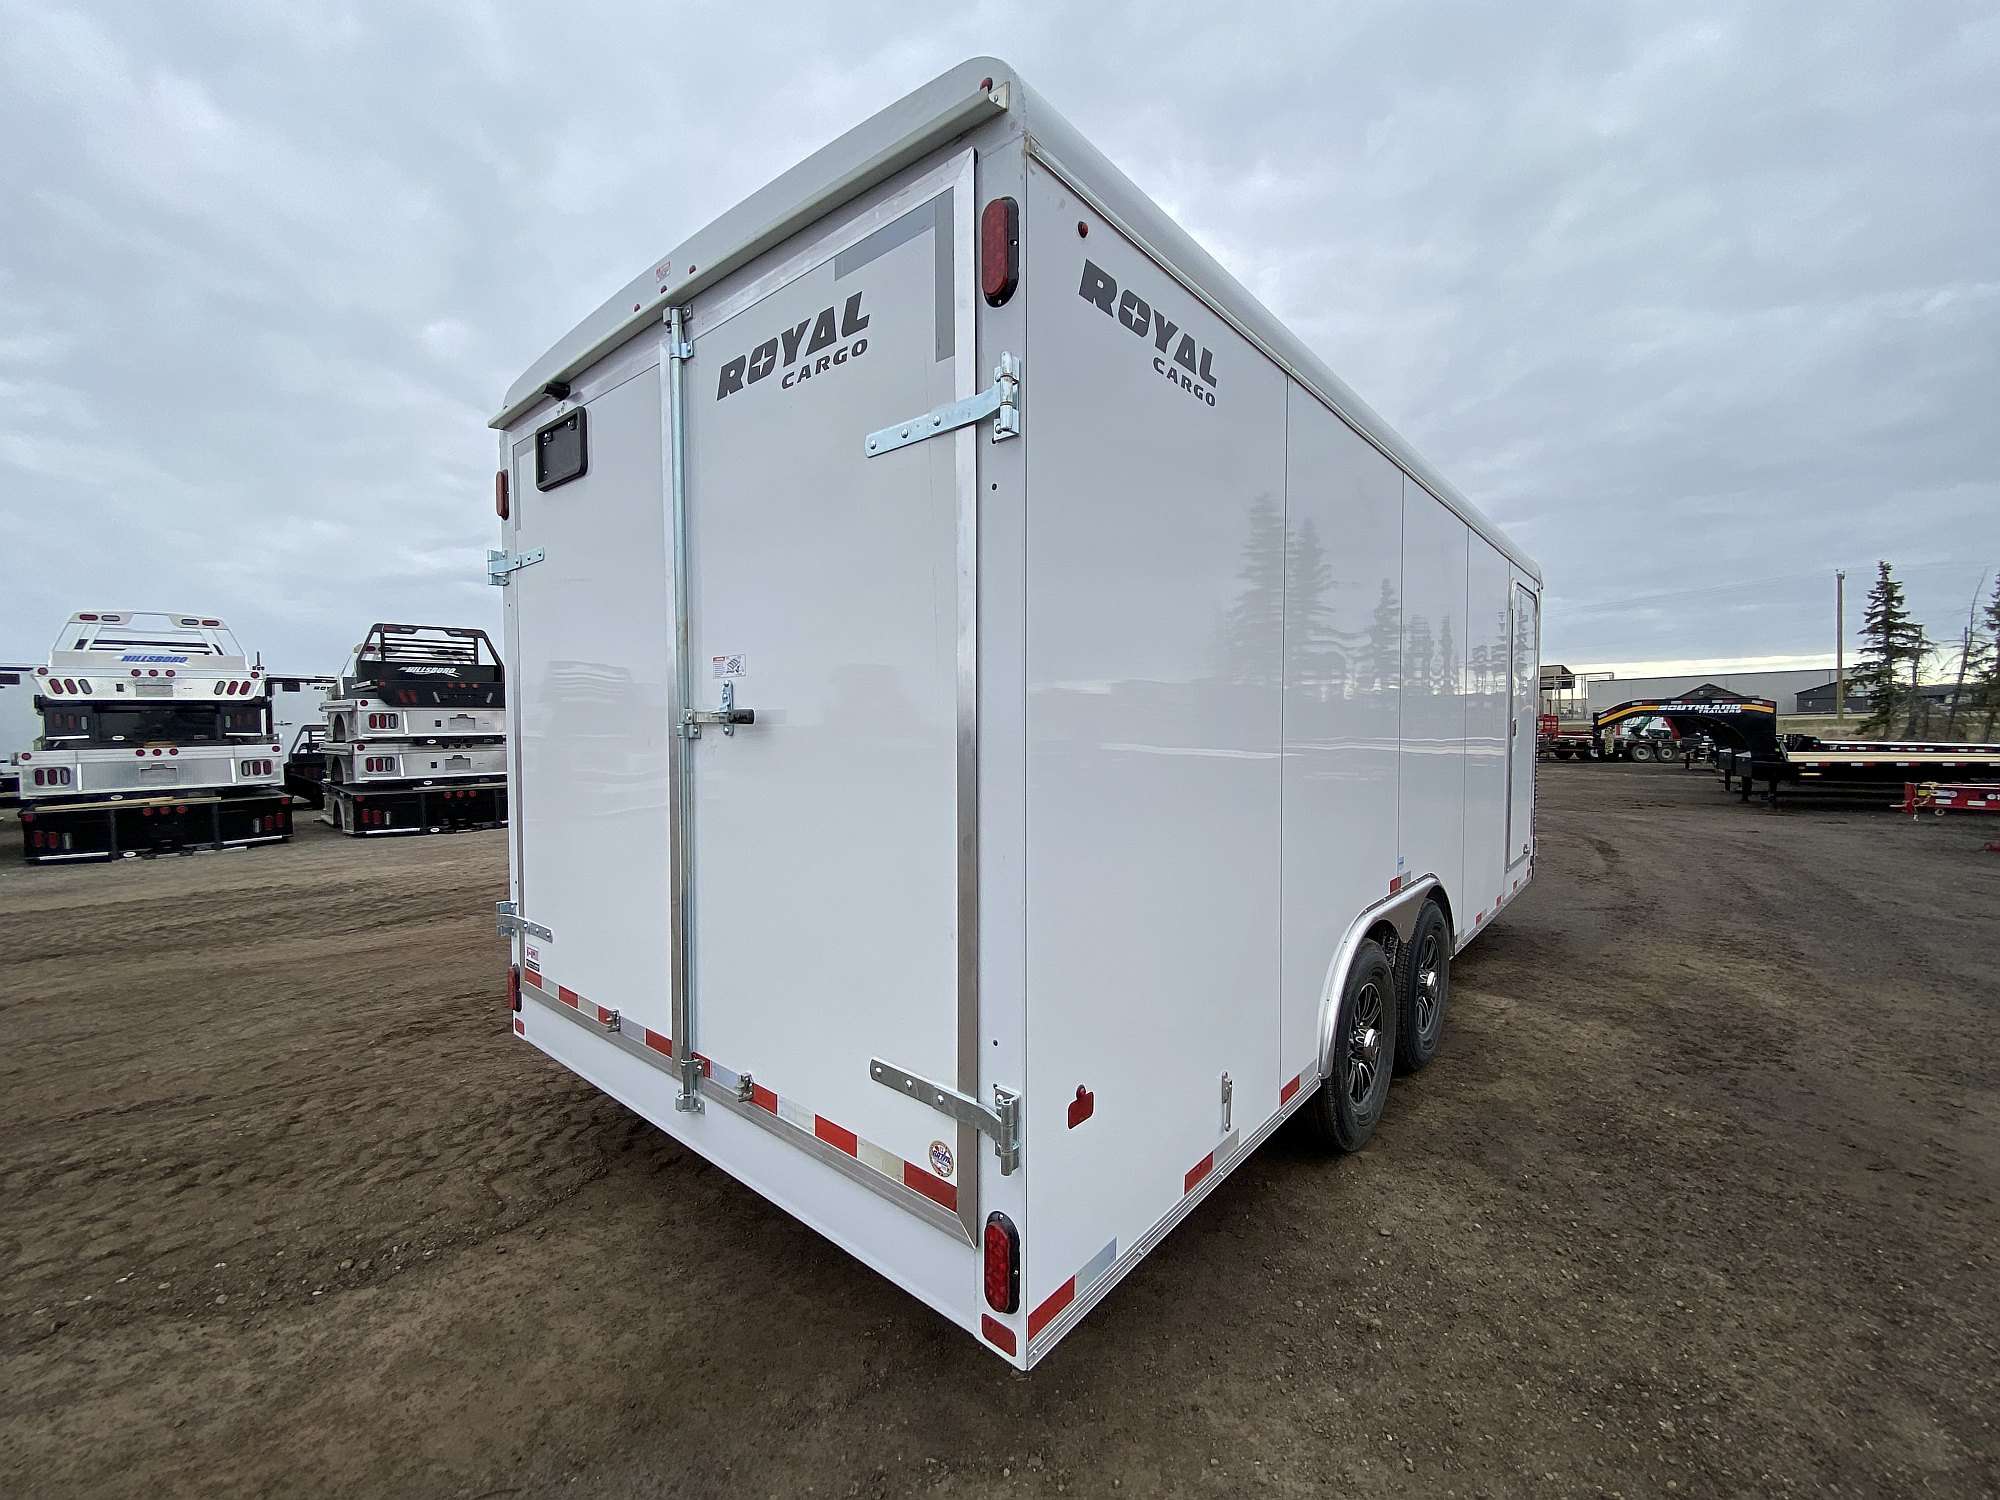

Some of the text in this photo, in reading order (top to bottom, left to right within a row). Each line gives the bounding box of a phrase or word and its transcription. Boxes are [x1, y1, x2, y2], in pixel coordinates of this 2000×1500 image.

[717, 291, 870, 401] ROYAL
[1079, 258, 1217, 388] ROYAL
[781, 338, 868, 390] CARGO
[1153, 357, 1216, 407] CARGO
[121, 655, 188, 663] HILLSBORO
[405, 666, 456, 674] HILLSBORO
